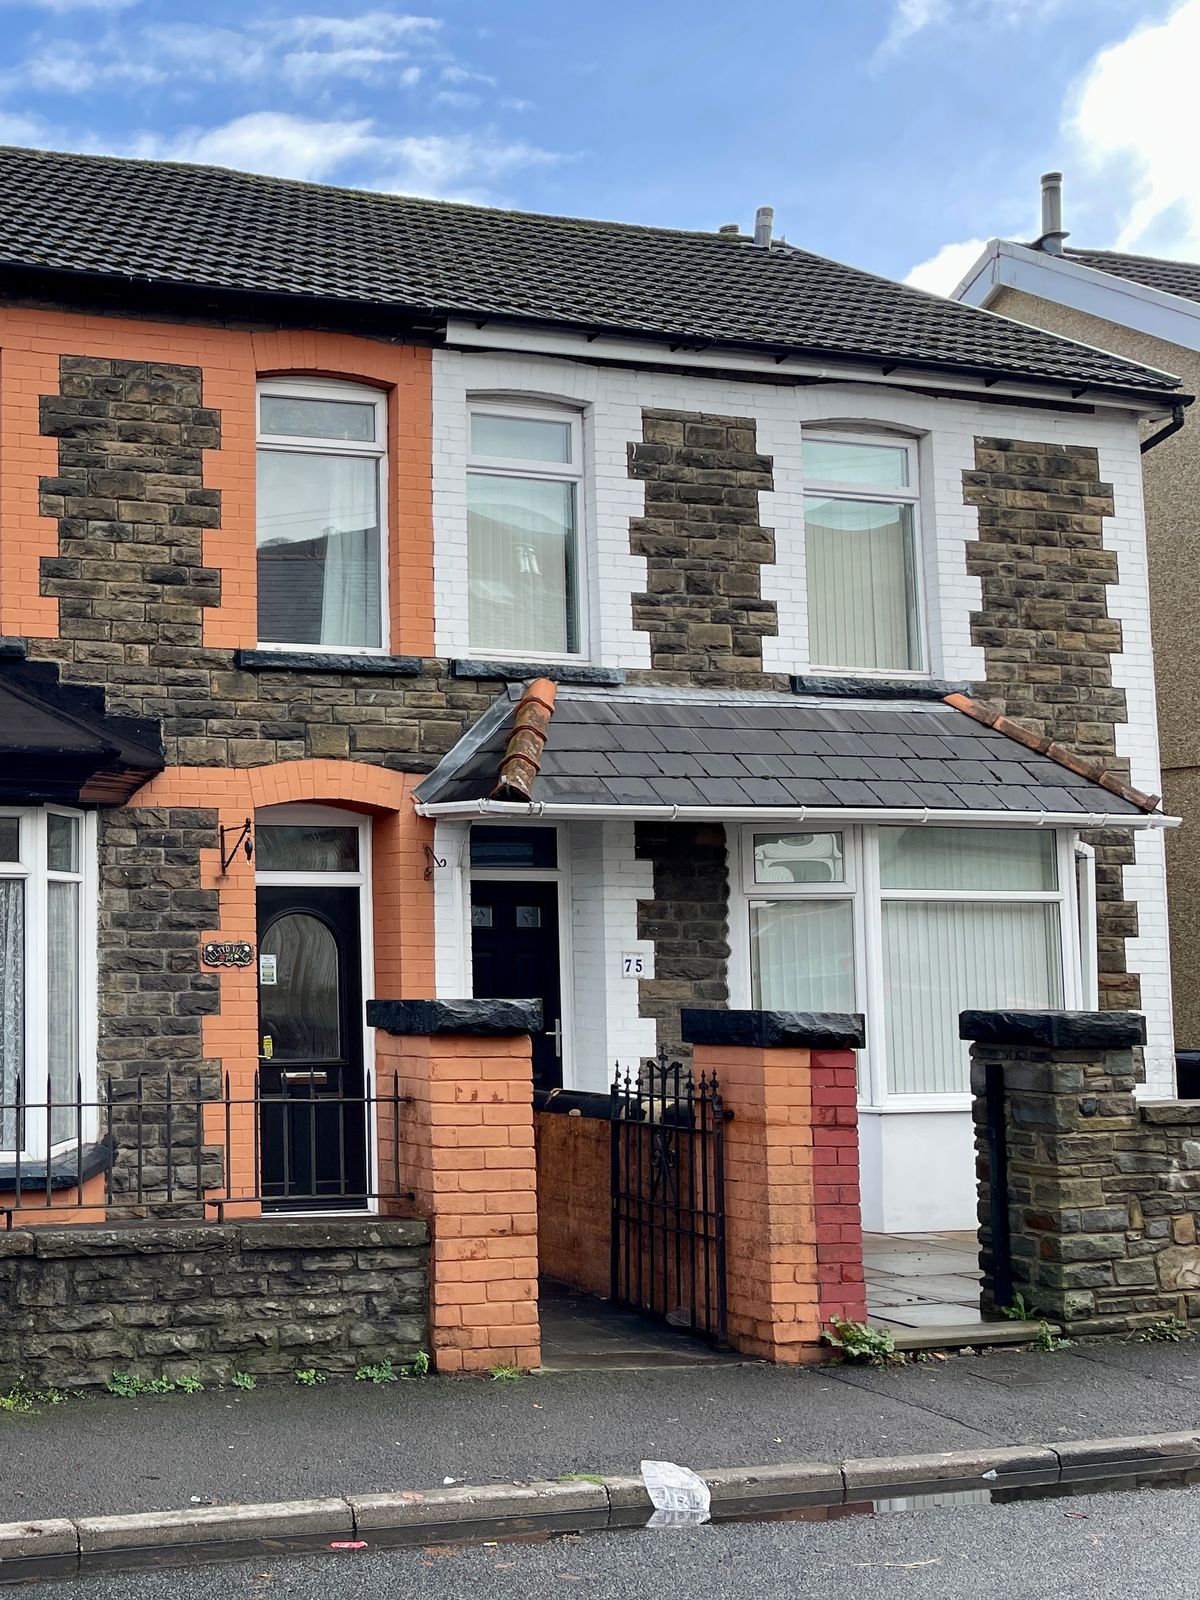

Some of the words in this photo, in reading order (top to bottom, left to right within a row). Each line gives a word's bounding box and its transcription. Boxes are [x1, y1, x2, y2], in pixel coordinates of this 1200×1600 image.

[207, 946, 230, 962] ILLTYD
[232, 946, 250, 963] VILLA
[224, 953, 234, 961] 74
[624, 959, 643, 973] 75
